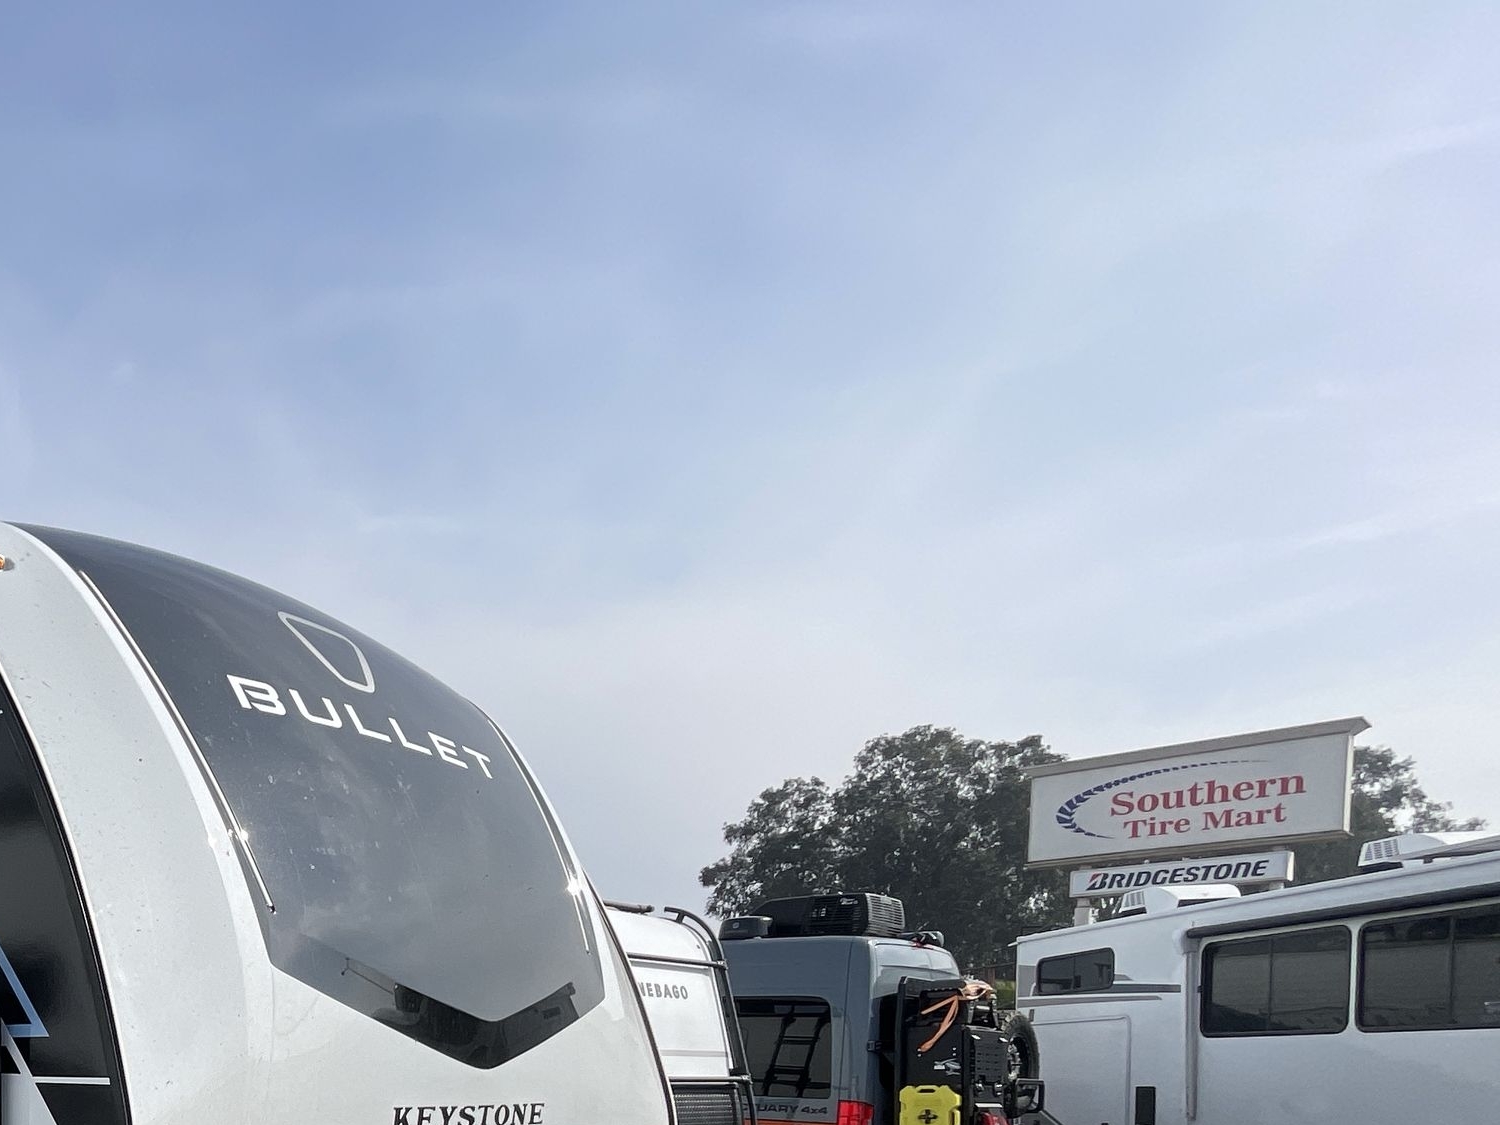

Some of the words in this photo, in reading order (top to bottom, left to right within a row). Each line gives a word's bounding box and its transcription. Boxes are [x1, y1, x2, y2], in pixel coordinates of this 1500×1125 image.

[226, 674, 493, 779] BULLET
[1110, 775, 1307, 817] Southern
[1123, 816, 1191, 839] Tire
[1202, 802, 1288, 831] Mart
[1086, 859, 1270, 891] BRIDGESTONE
[801, 1105, 828, 1115] 4x4
